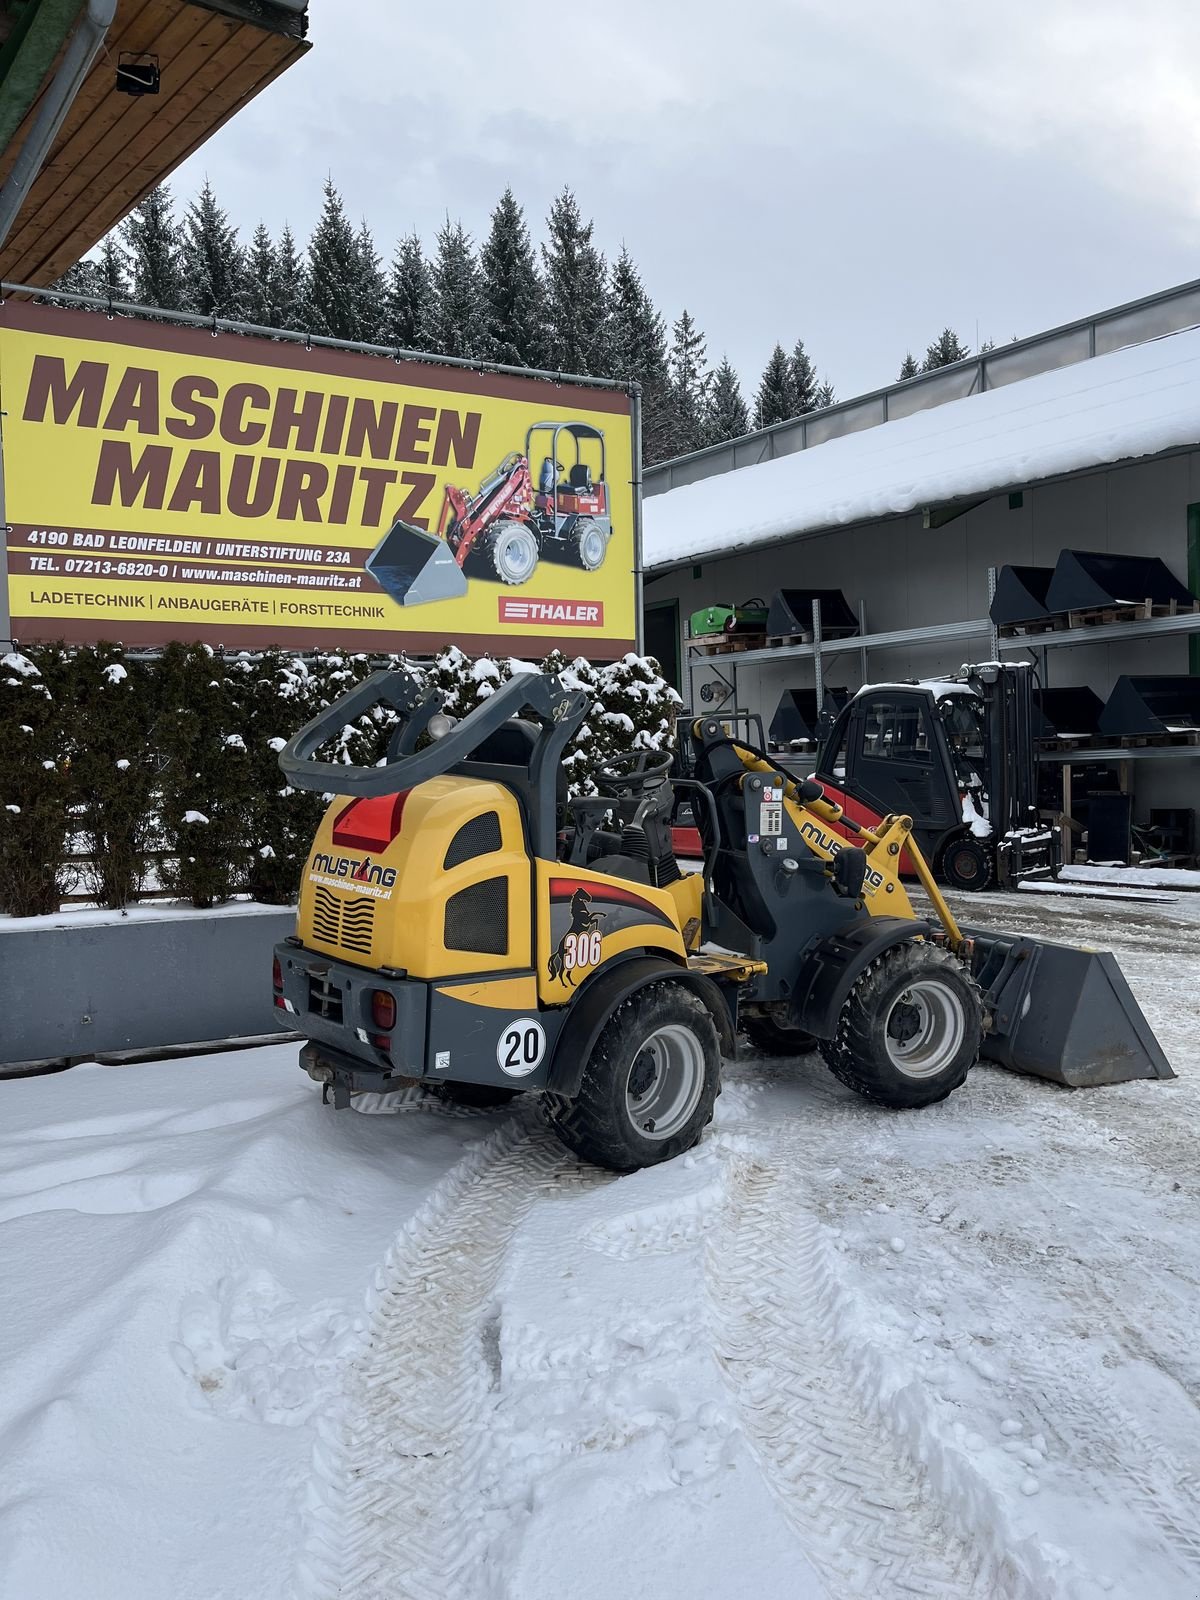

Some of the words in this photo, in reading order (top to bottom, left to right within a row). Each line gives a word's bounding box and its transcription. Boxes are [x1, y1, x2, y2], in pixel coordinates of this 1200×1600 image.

[22, 354, 483, 470] MASCHINEN
[91, 439, 437, 530] MAURITZ
[28, 530, 69, 546] 4190
[73, 533, 105, 548] BAD
[109, 536, 202, 555] LEONFELDEN
[215, 543, 322, 562] UNTERSTIFTUNG
[325, 551, 351, 564] 23A
[29, 557, 60, 572] TEL.
[65, 559, 168, 577] 07213-6820-0
[181, 568, 362, 588] www.maschinen-mauritz.at
[30, 591, 146, 608] LADETECHNIK
[157, 597, 269, 613] ANBAUGERÄTE
[280, 602, 385, 618] FORSTTECHNIK
[529, 603, 599, 621] THALER
[800, 821, 884, 888] MUSNG
[564, 930, 603, 970] 306
[505, 1028, 539, 1068] 20
